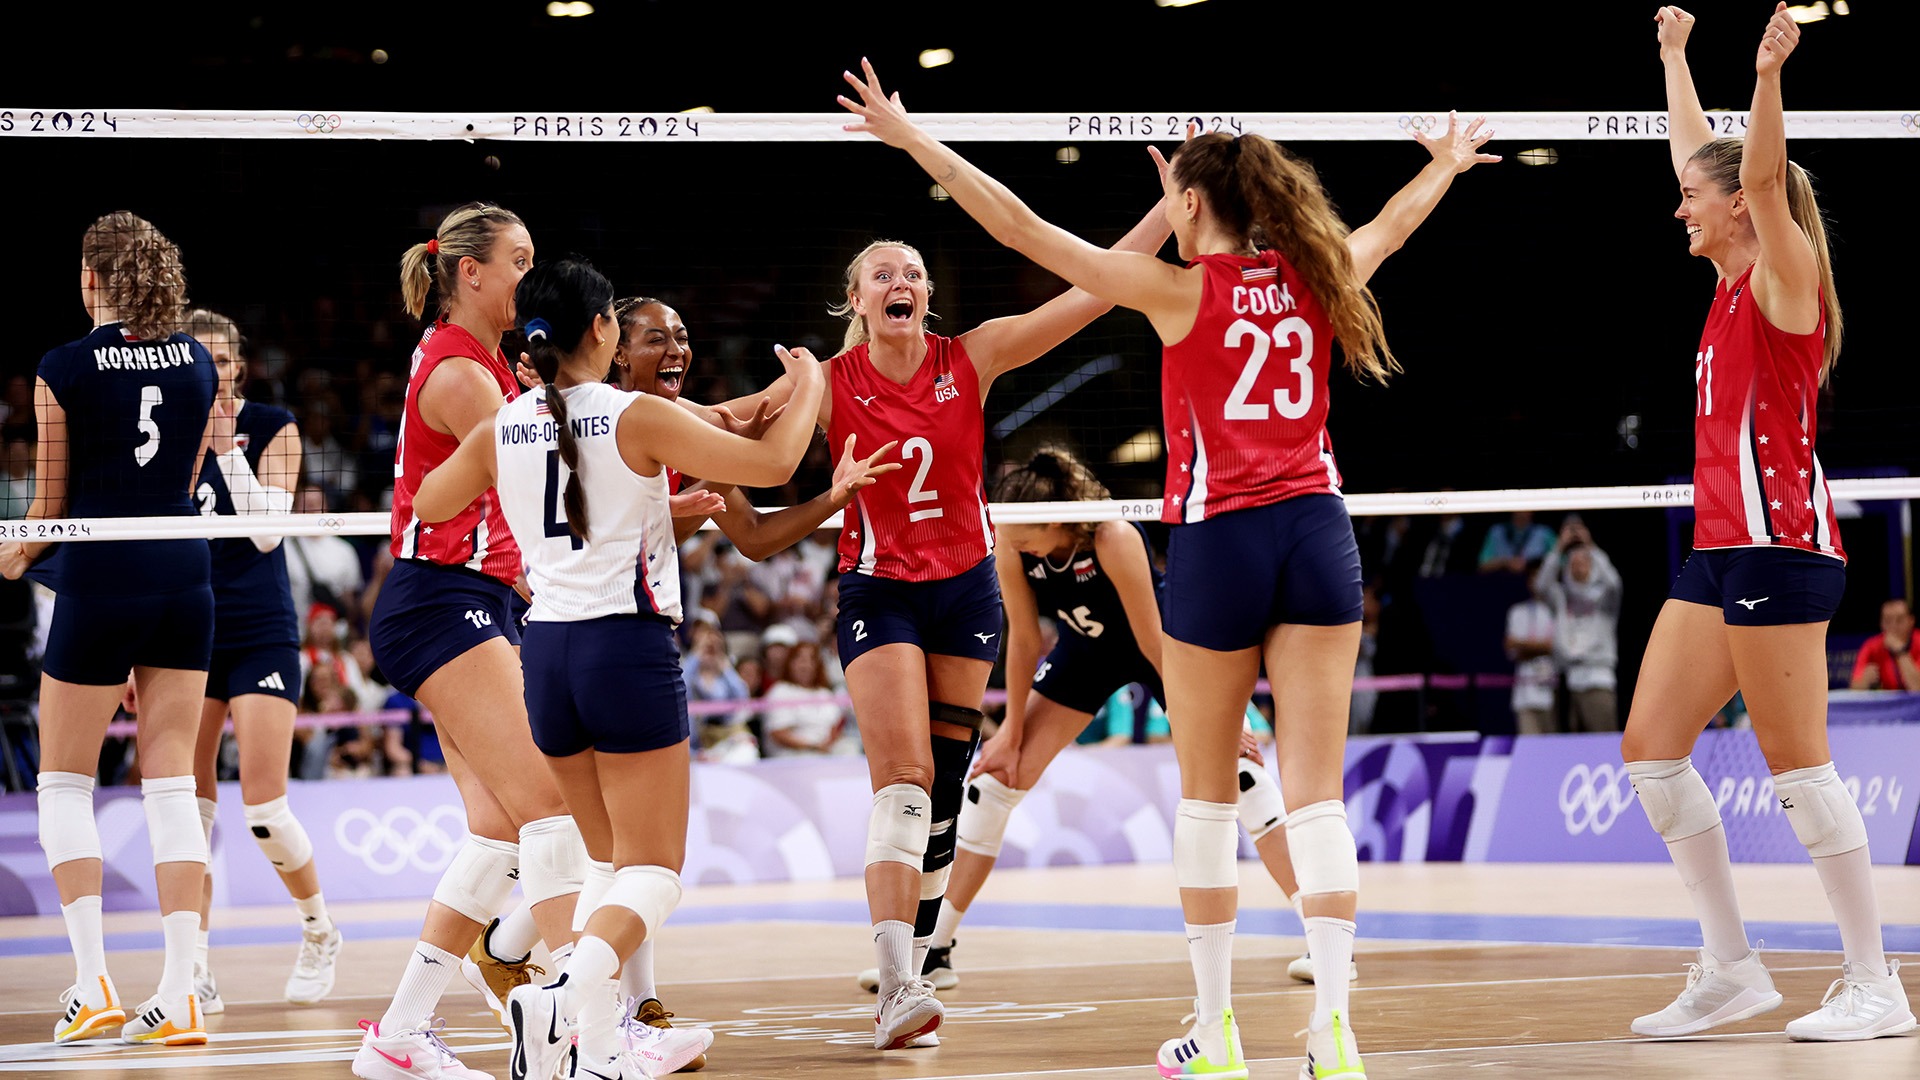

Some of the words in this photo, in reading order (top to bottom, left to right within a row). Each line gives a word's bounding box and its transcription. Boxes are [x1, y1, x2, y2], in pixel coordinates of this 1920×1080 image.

[30, 111, 117, 132] 2024
[619, 116, 699, 136] 2024
[1232, 282, 1298, 316] COOK
[94, 342, 194, 371] KORNELUK
[1224, 316, 1314, 421] 23
[935, 384, 960, 403] USA
[134, 386, 163, 467] 5
[502, 415, 610, 445] WONG-ORNTES
[902, 436, 938, 504] 2
[543, 449, 584, 551] 4
[37, 524, 91, 537] 2024
[464, 609, 492, 629] 10
[852, 620, 868, 642] 2
[1057, 605, 1105, 639] 15
